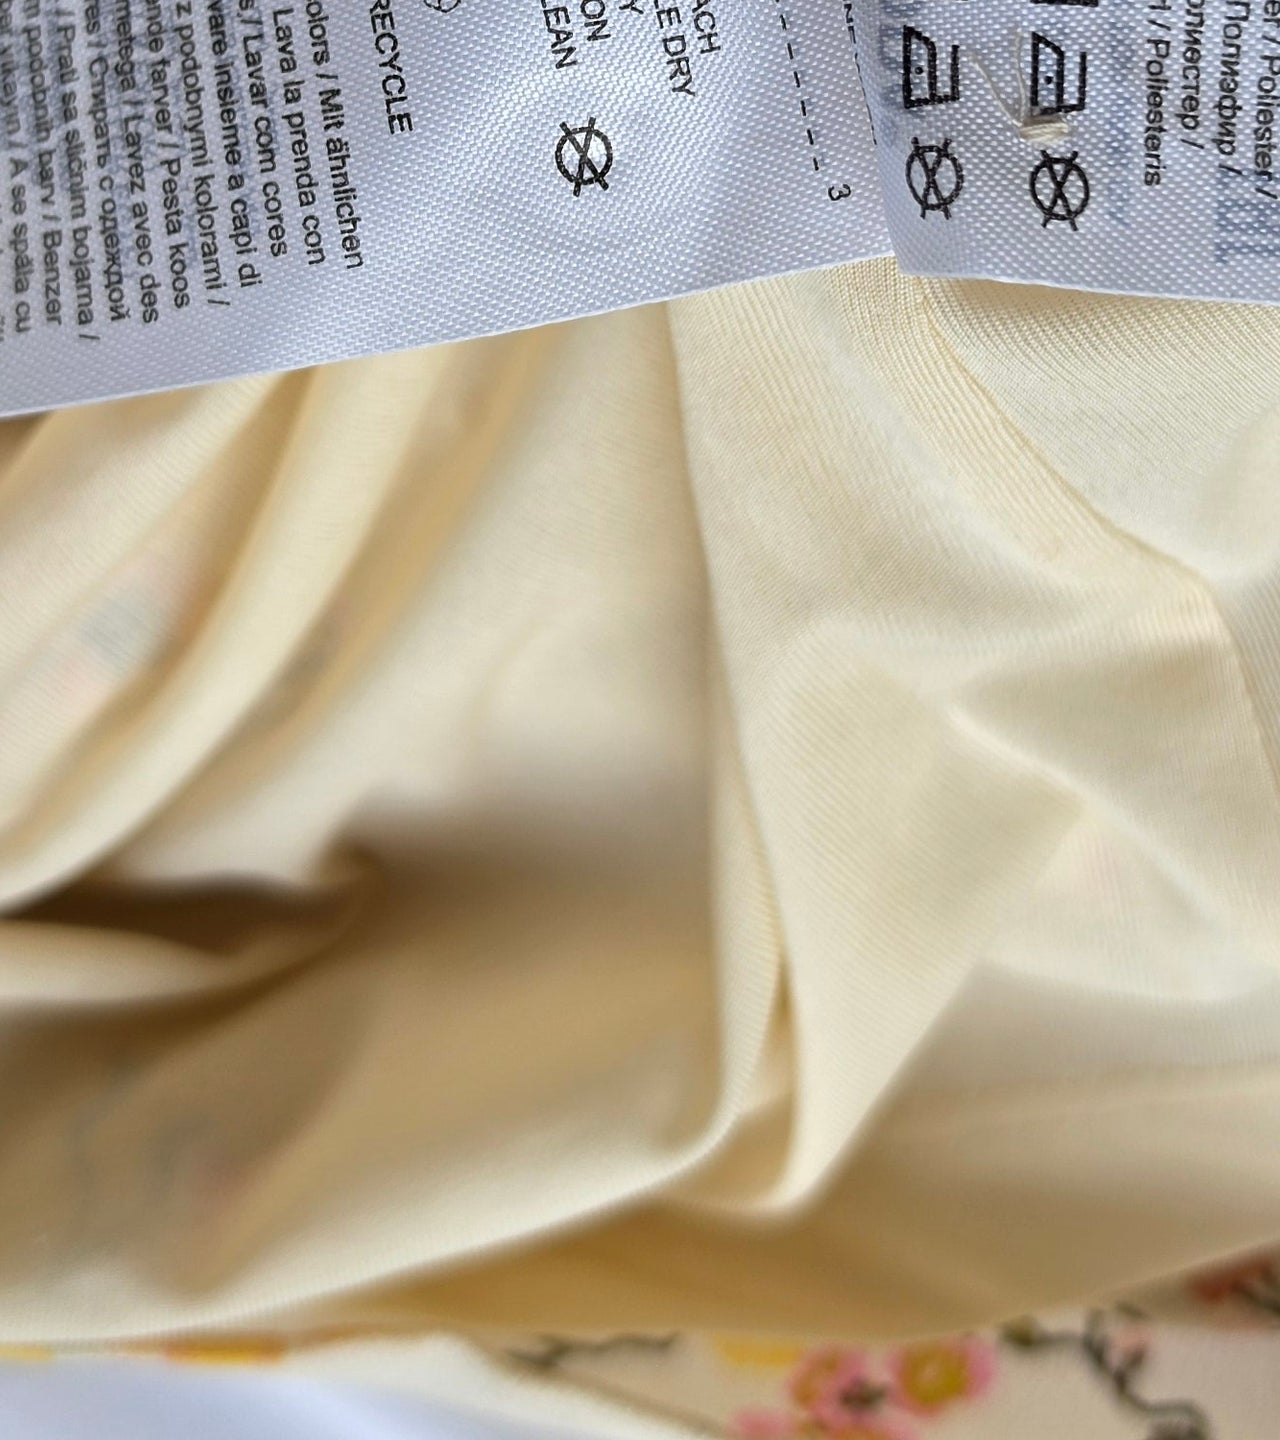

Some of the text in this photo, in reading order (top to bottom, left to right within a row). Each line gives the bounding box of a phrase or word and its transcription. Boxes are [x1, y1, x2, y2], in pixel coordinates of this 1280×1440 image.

[242, 34, 271, 110] Lavar
[272, 8, 300, 73] Lava
[661, 34, 696, 99] DRY
[282, 80, 304, 105] la
[318, 88, 343, 131] Mit
[1144, 37, 1169, 187] Poliesteris
[253, 115, 275, 173] com
[281, 111, 318, 208] prenda
[226, 172, 243, 191] a
[325, 135, 365, 269] ähnlichen
[827, 182, 851, 202] 3
[192, 174, 225, 291] kolorami
[224, 197, 255, 256] capi
[261, 180, 286, 258] cores
[301, 214, 323, 266] con
[168, 242, 193, 309] koos
[237, 261, 260, 288] di
